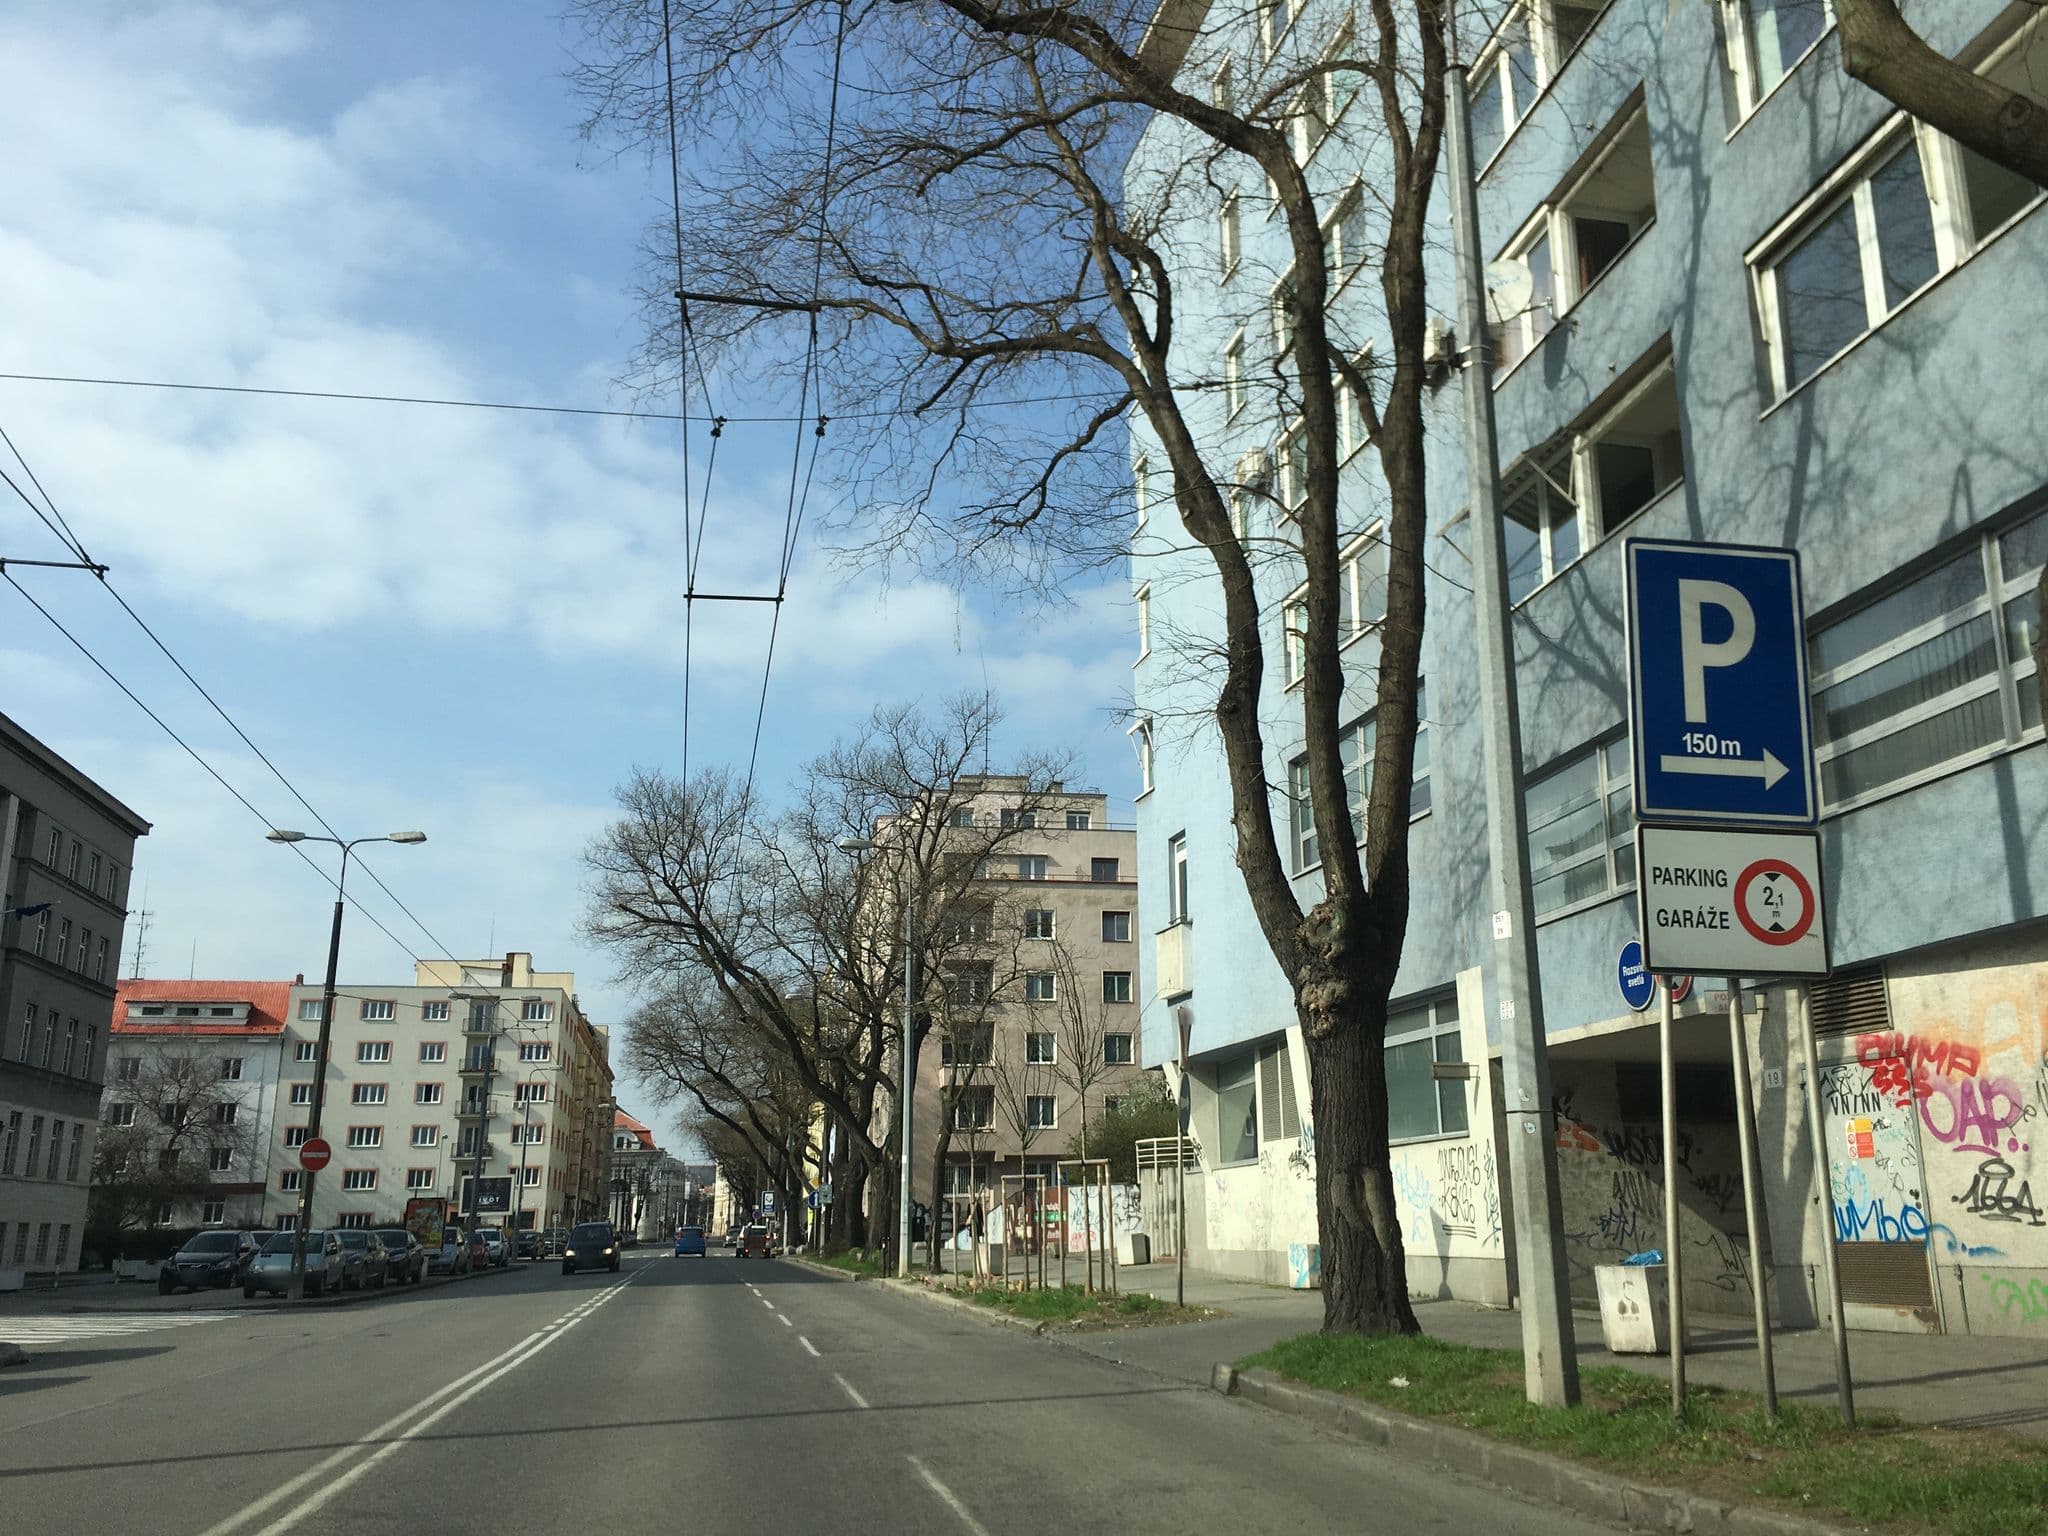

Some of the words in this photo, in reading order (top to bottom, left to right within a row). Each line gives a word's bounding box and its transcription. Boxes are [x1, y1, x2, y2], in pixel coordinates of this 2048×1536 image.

[1679, 578, 1756, 723] P
[1682, 733, 1717, 755] 150
[1721, 739, 1741, 756] m
[1652, 866, 1728, 888] PARKING
[1763, 886, 1784, 909] 2,1
[1656, 905, 1730, 930] GARÁŽE
[1767, 1071, 1779, 1085] 19
